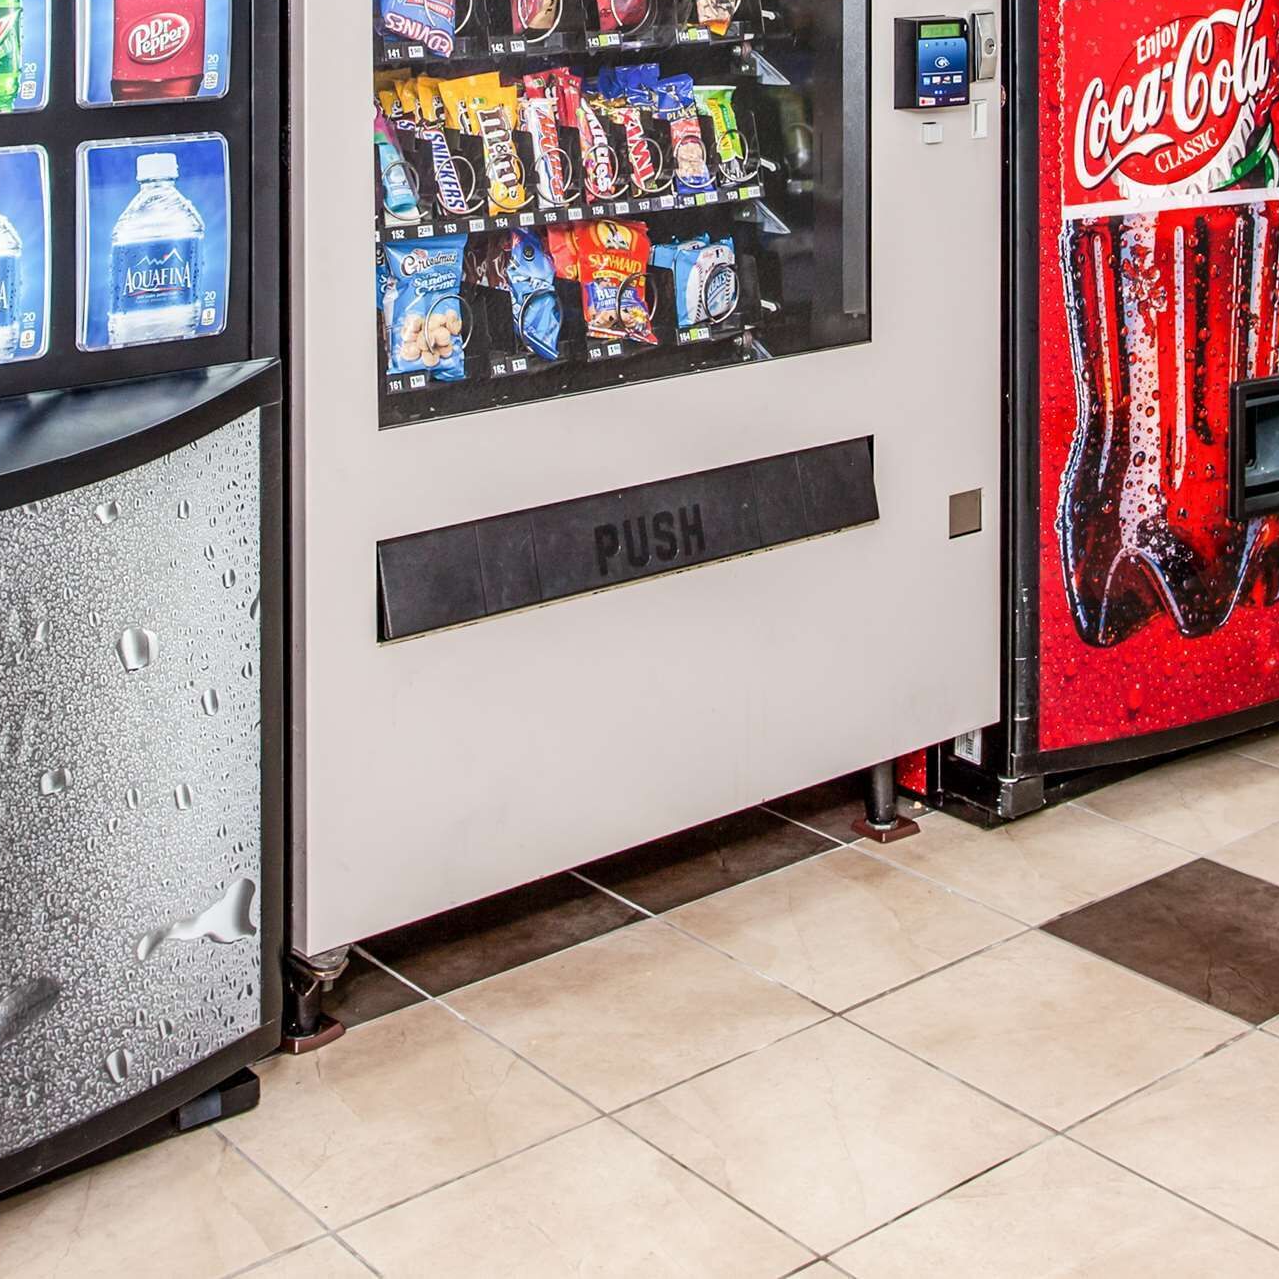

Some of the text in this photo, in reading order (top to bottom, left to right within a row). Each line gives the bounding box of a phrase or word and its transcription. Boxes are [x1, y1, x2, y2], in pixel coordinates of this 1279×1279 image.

[134, 18, 186, 57] Dr Pepper
[1135, 19, 1181, 65] Enjoy
[491, 43, 504, 53] 142
[207, 53, 219, 64] 20
[387, 49, 400, 59] 141
[23, 62, 37, 73] 20
[1154, 126, 1220, 174] CLASSIC
[592, 205, 605, 215] 156
[638, 201, 650, 211] 157
[544, 211, 557, 222] 155
[495, 217, 509, 228] 154
[444, 223, 457, 234] 153
[391, 229, 405, 240] 152
[122, 261, 191, 296] AQUAFINA
[204, 290, 217, 301] 20
[23, 312, 36, 323] 20
[492, 364, 505, 374] 162
[389, 380, 403, 390] 161
[594, 502, 707, 576] PUSH
